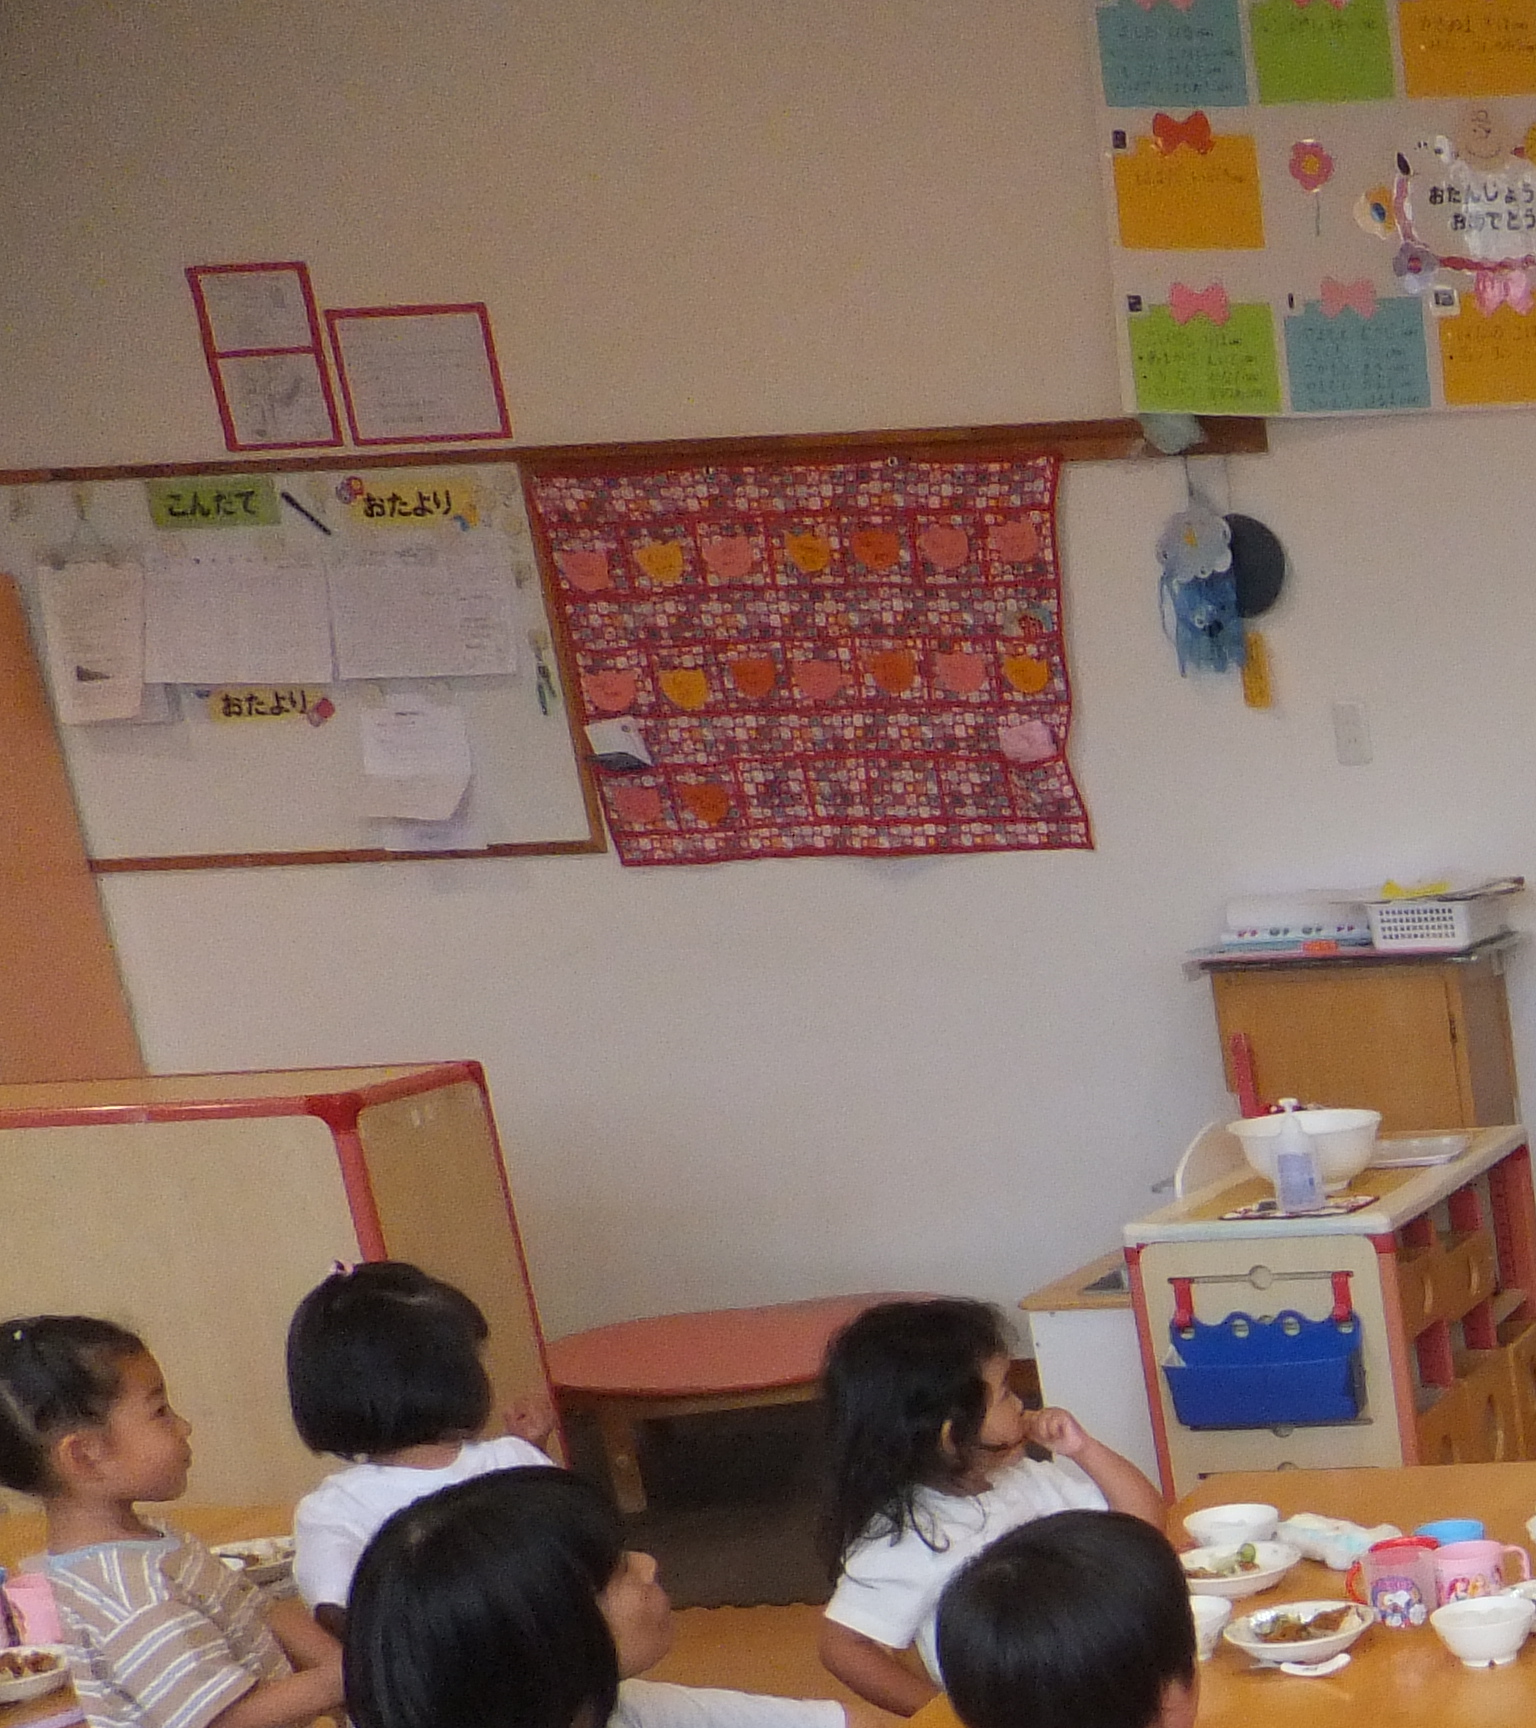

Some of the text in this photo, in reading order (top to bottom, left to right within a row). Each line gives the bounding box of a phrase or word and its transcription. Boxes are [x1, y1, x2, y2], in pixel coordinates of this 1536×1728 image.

[167, 490, 258, 518] こんだて
[362, 489, 452, 518] おたより
[221, 689, 308, 717] おたより
